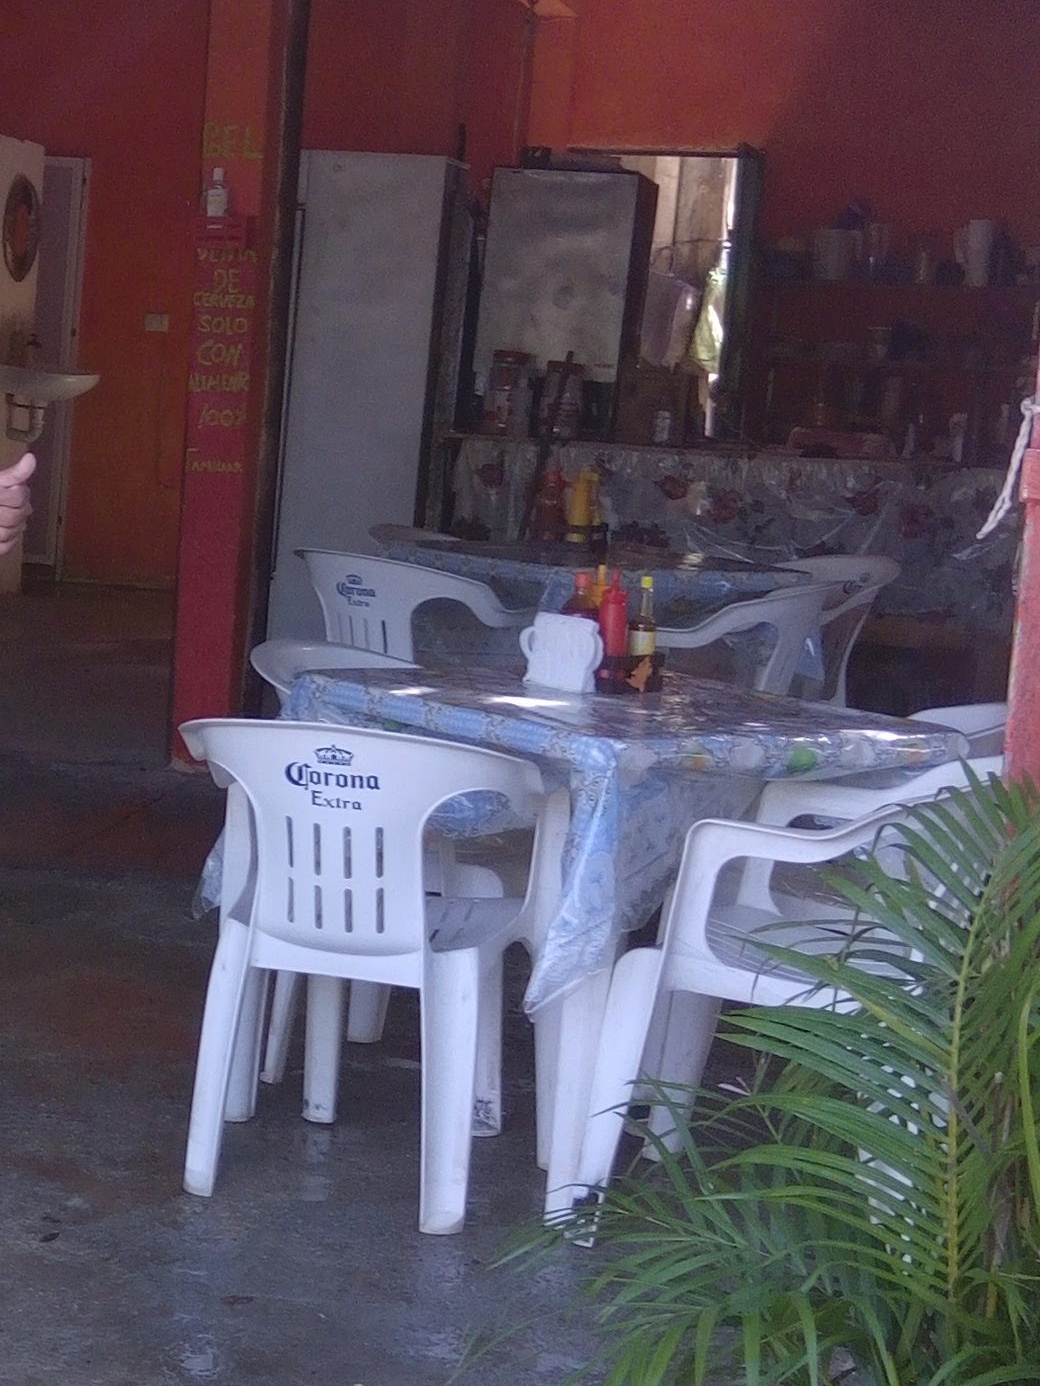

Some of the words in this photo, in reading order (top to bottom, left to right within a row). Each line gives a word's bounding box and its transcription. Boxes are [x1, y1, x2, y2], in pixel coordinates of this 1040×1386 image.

[198, 315, 248, 334] SOLO
[197, 339, 244, 366] CON
[284, 761, 381, 791] Corona
[311, 789, 363, 811] Extra
